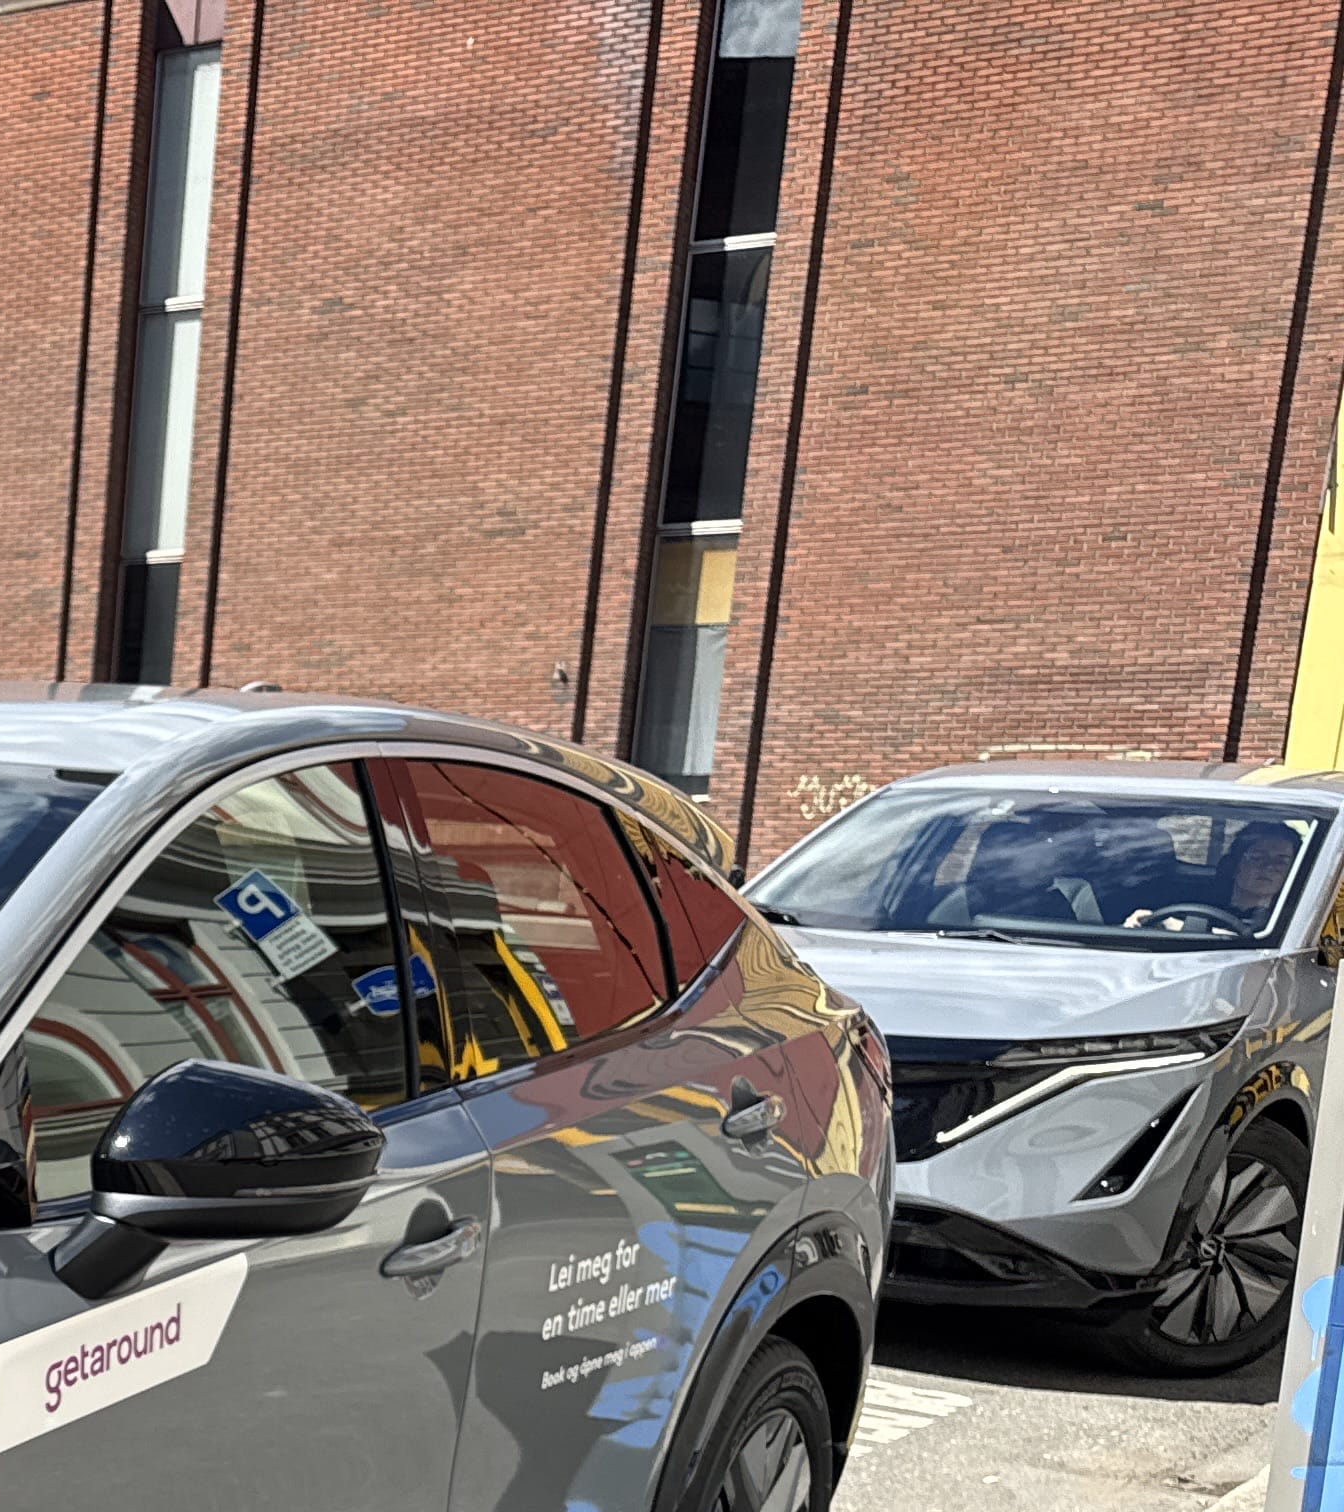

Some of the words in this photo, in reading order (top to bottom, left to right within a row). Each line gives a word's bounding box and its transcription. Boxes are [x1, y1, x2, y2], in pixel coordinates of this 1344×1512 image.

[548, 1253, 576, 1292] Lei
[576, 1250, 612, 1285] meg
[615, 1238, 640, 1270] for
[541, 1313, 563, 1341] en
[568, 1297, 606, 1332] time
[608, 1282, 643, 1317] eller
[644, 1275, 678, 1306] mer
[44, 1302, 182, 1413] getaround
[541, 1365, 565, 1390] Book
[566, 1363, 579, 1384] og
[603, 1347, 624, 1367] meg
